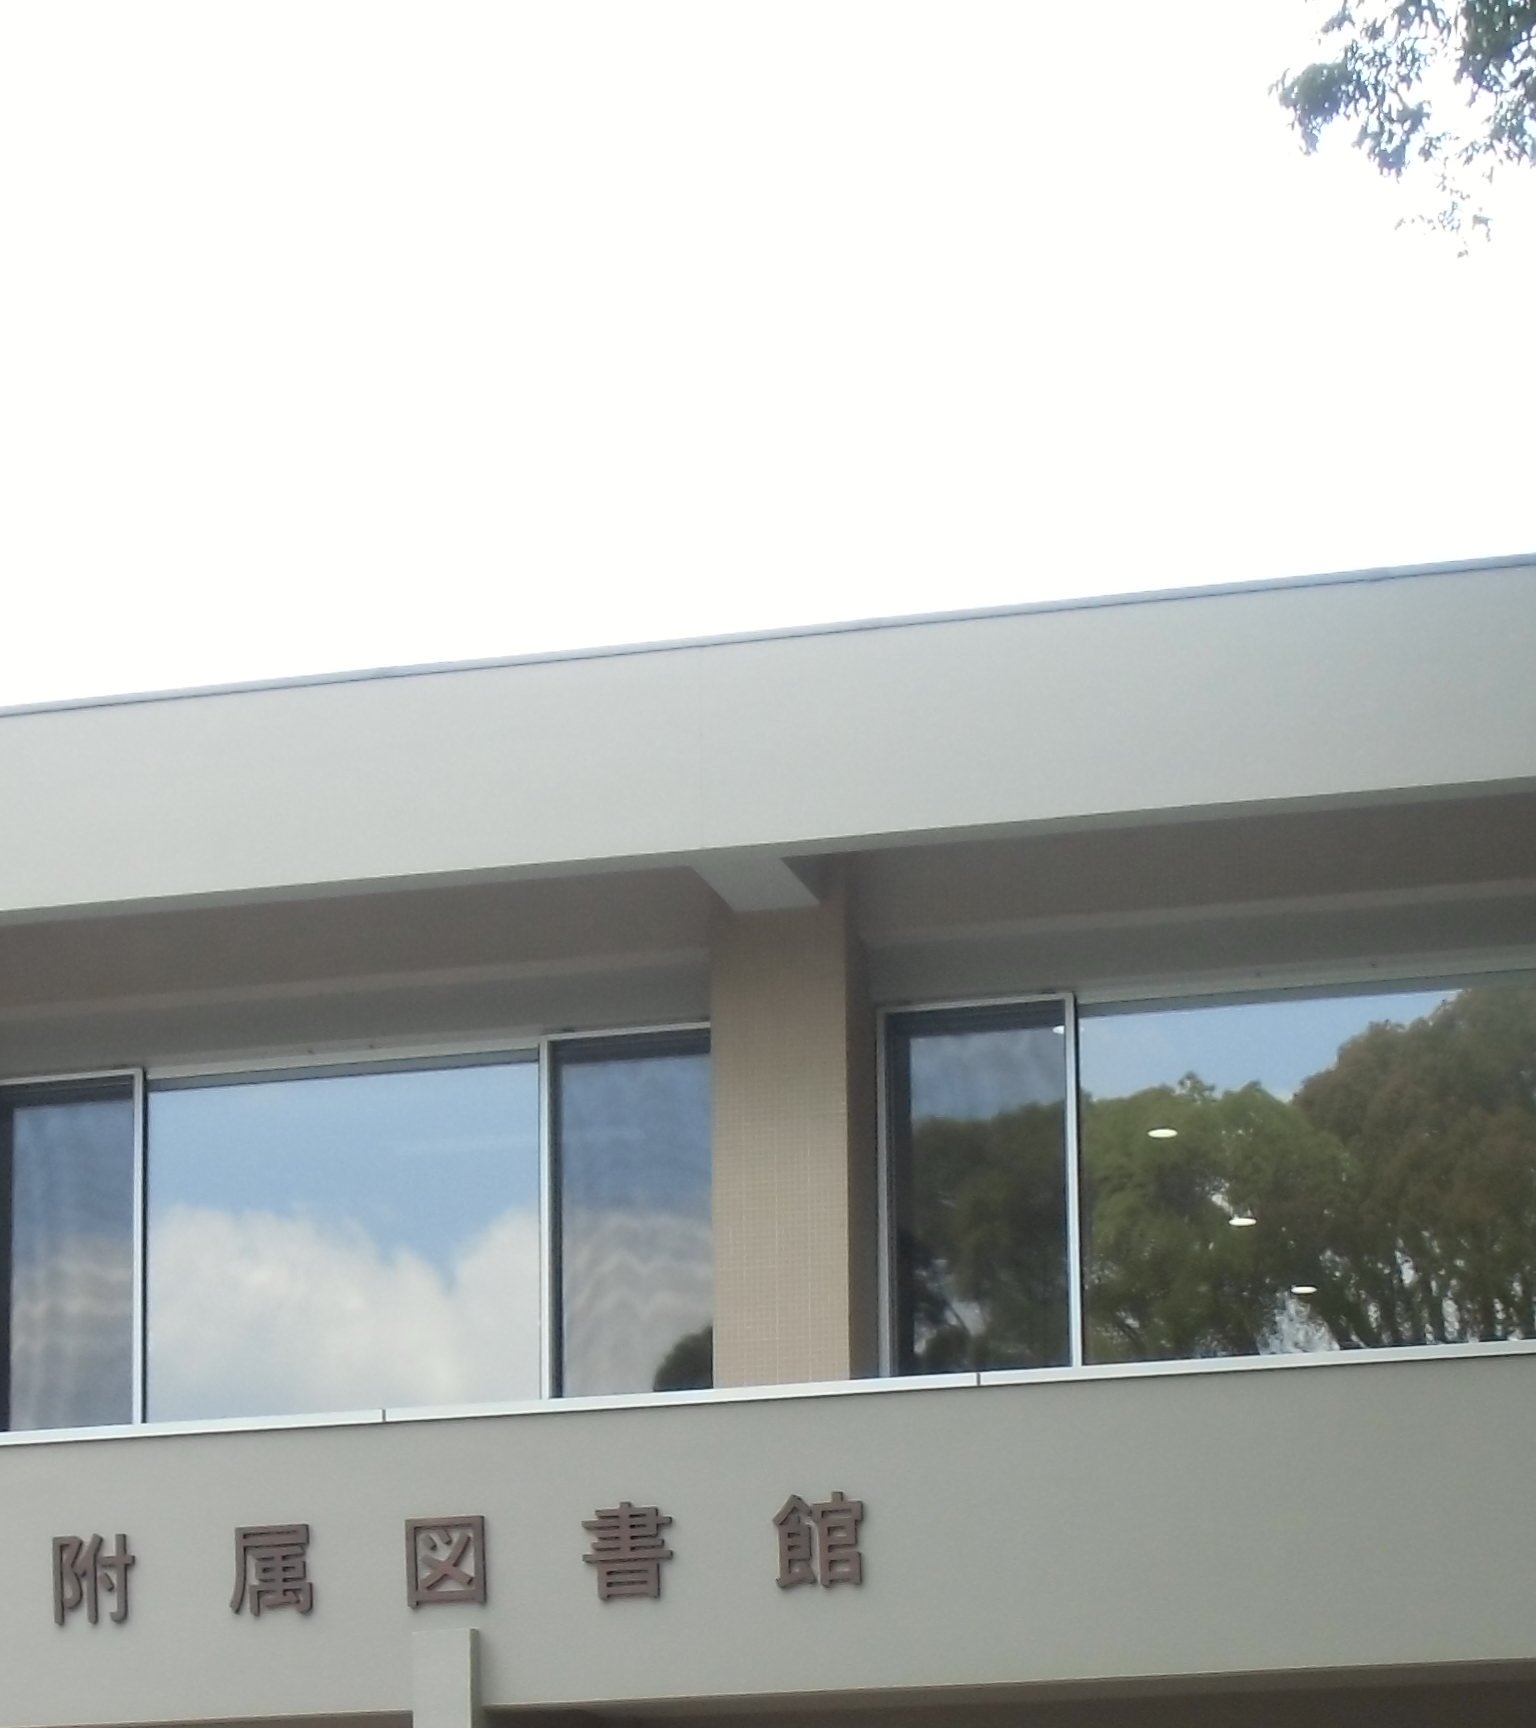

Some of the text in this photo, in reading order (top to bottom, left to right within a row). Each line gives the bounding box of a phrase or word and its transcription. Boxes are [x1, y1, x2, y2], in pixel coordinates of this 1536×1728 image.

[51, 1490, 866, 1627] 附属図書館
